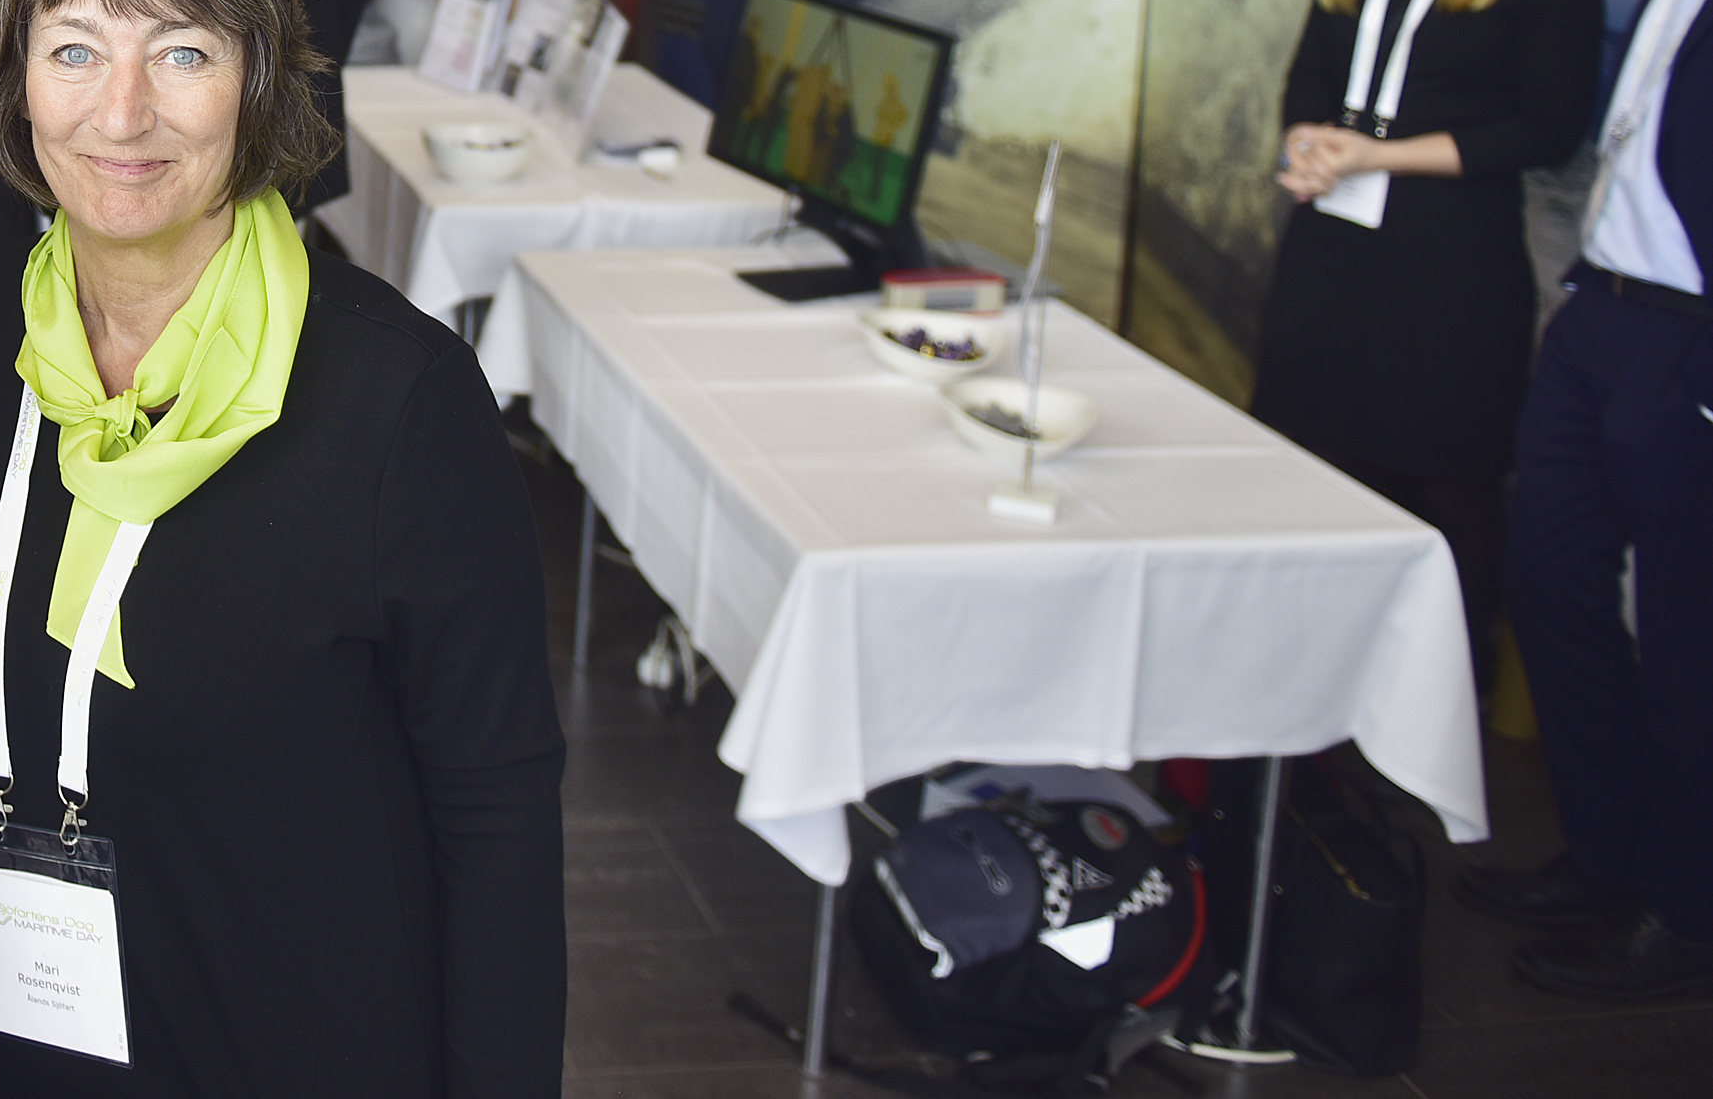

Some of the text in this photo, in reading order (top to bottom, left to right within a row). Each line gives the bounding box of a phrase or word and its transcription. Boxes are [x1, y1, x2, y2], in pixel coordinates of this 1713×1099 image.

[11, 392, 33, 480] MARITIME DAY
[18, 443, 32, 471] Dag
[14, 918, 104, 945] MARITIME DAY
[64, 916, 95, 934] Dag
[34, 961, 60, 977] Mari
[17, 972, 82, 997] Rosenqvist
